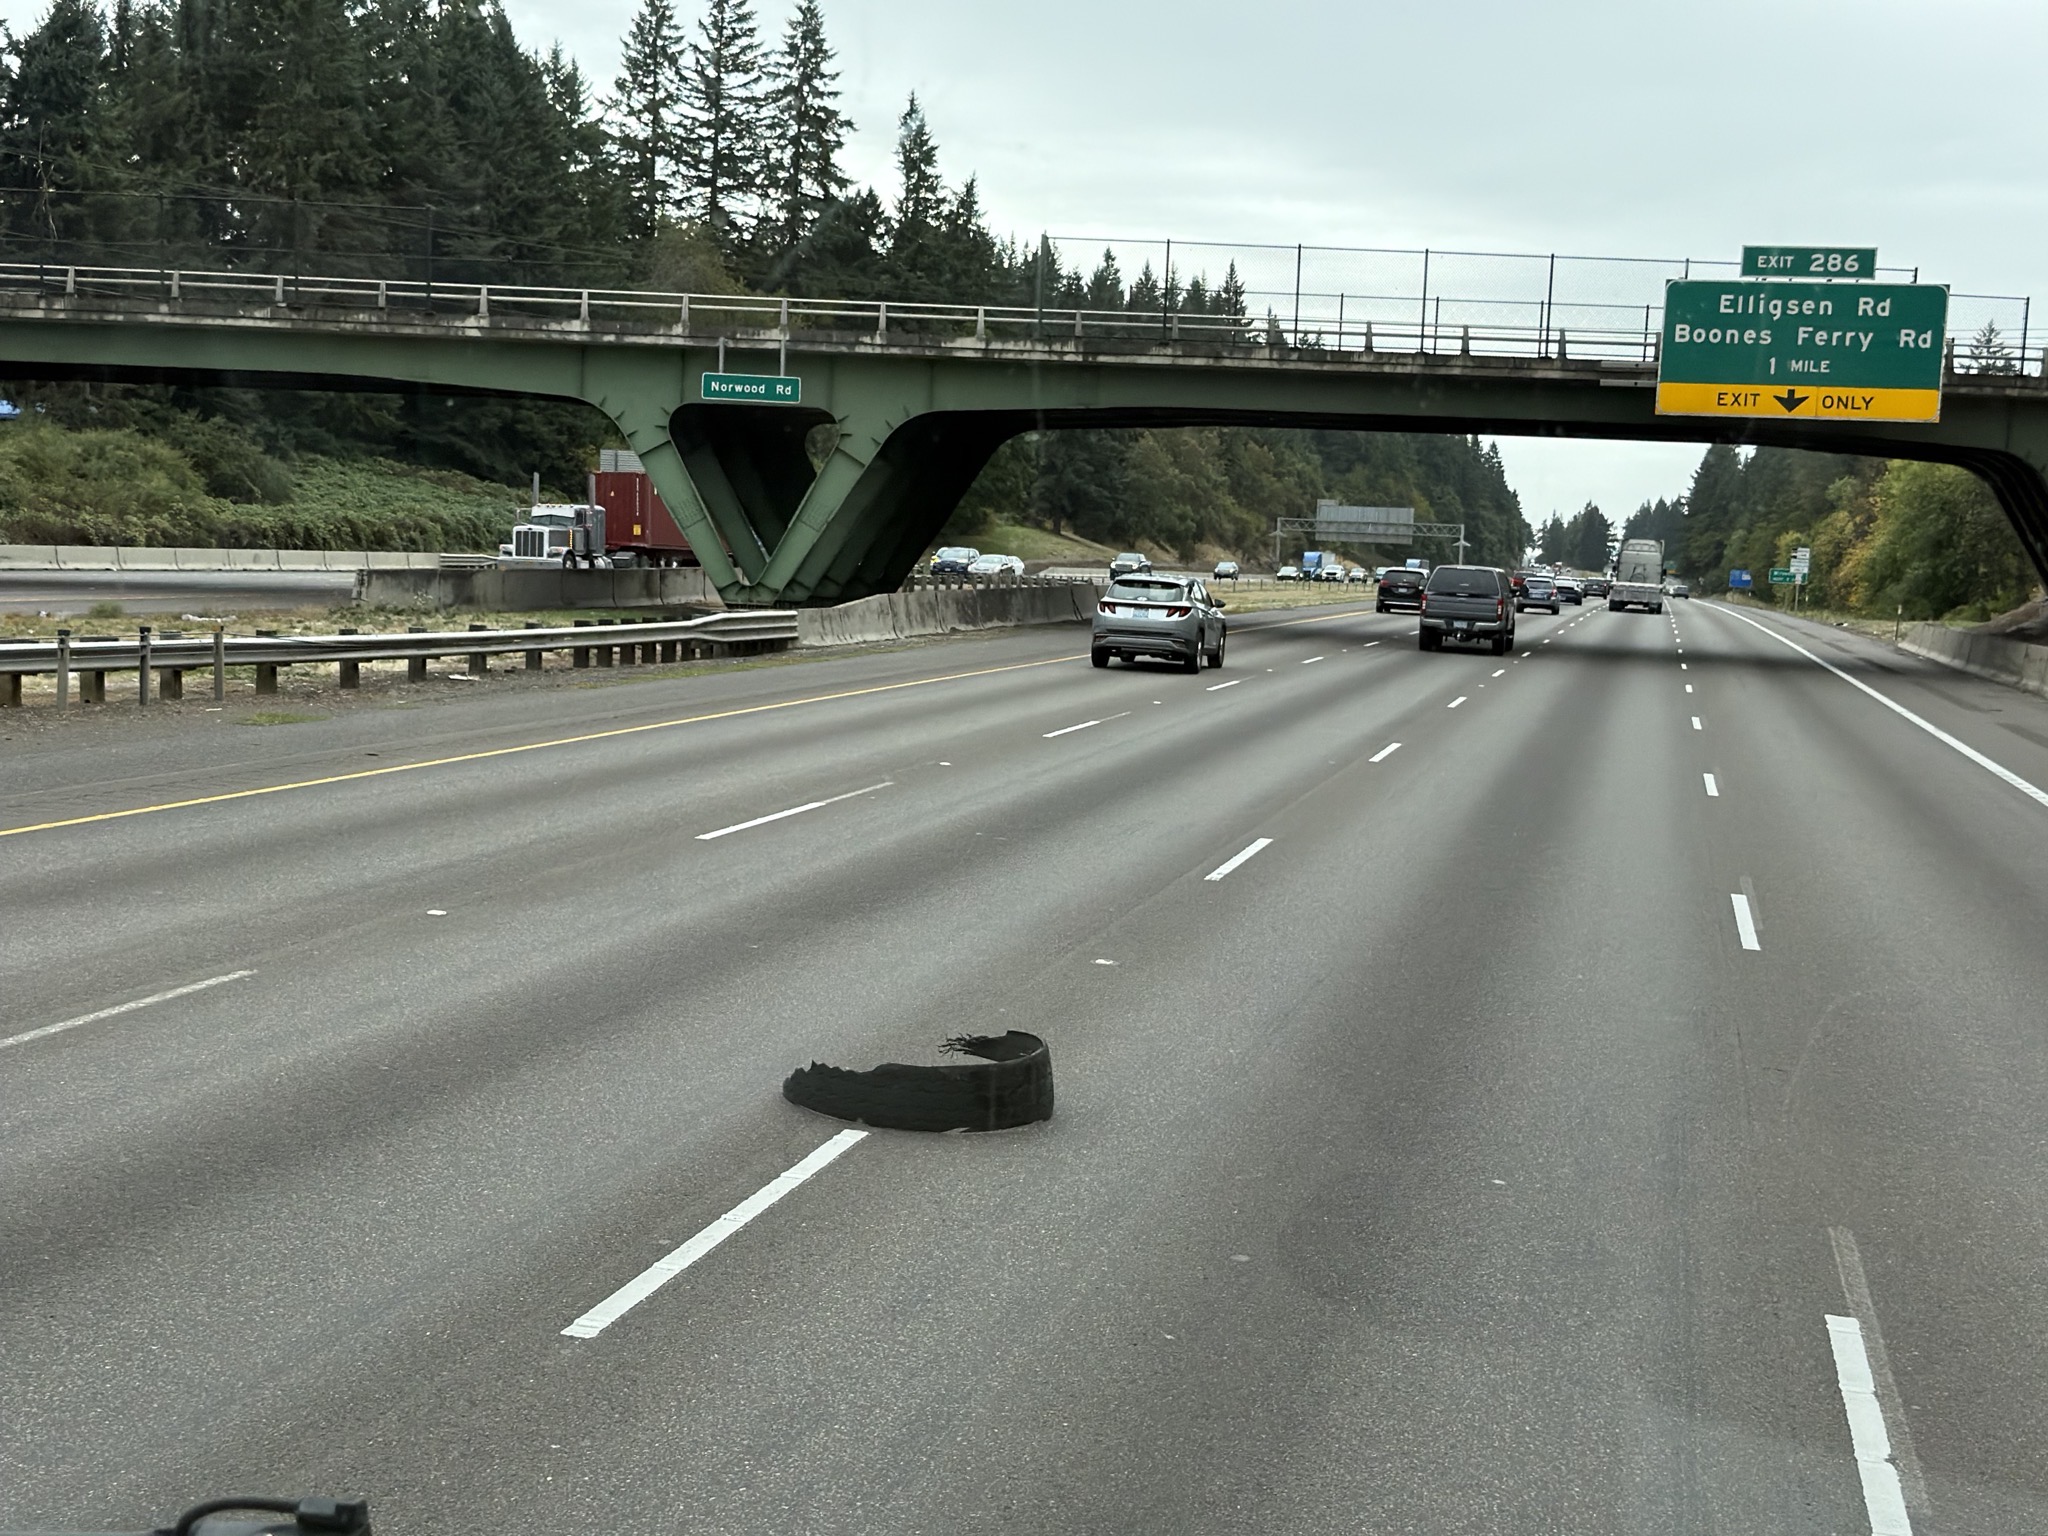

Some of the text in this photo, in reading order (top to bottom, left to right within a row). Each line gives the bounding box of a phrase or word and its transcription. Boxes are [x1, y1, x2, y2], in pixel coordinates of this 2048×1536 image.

[1757, 253, 1859, 272] EXIT 286
[1719, 294, 1891, 321] Elligsen Rd
[1674, 324, 1932, 352] Boones Ferry Rd
[1769, 357, 1830, 375] 1 MILE
[711, 381, 792, 395] Norwood Rd
[1717, 392, 1874, 411] EXIT ONLY
